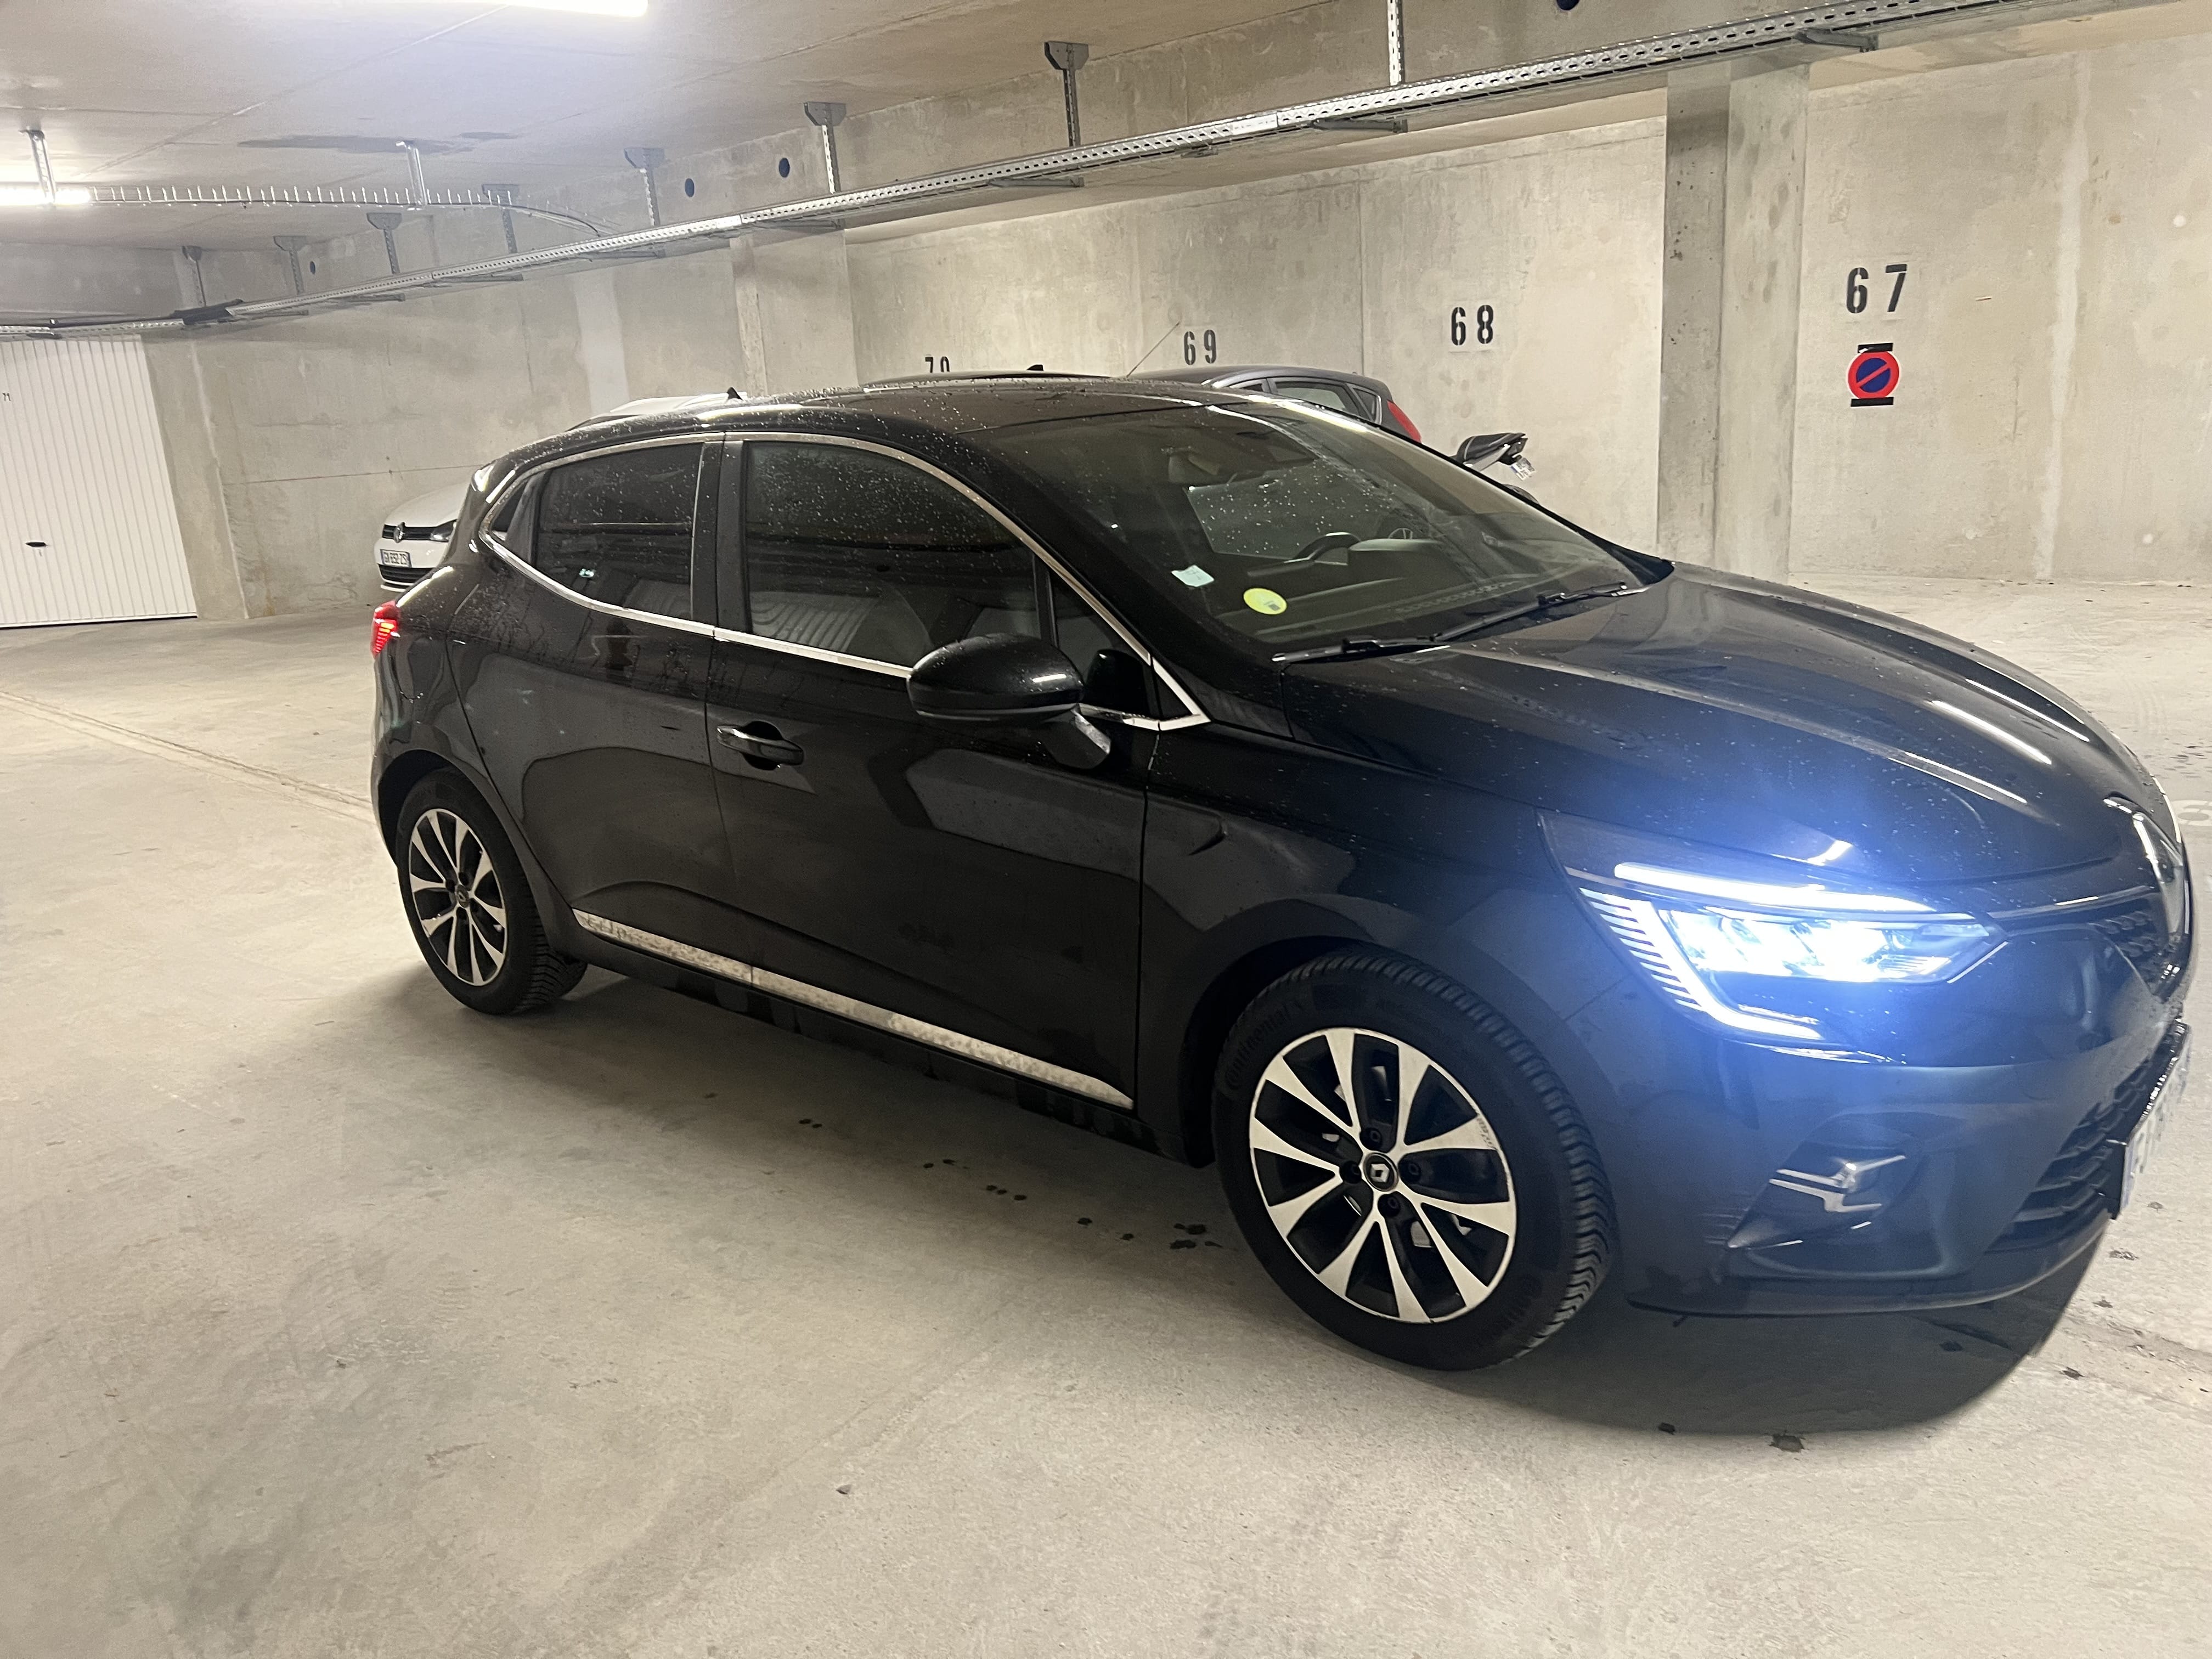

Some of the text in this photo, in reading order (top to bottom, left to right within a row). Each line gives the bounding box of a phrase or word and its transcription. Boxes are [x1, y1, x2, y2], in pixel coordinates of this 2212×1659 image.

[1847, 264, 1907, 314] 67
[1451, 305, 1493, 346] 68
[1184, 330, 1216, 365] 69
